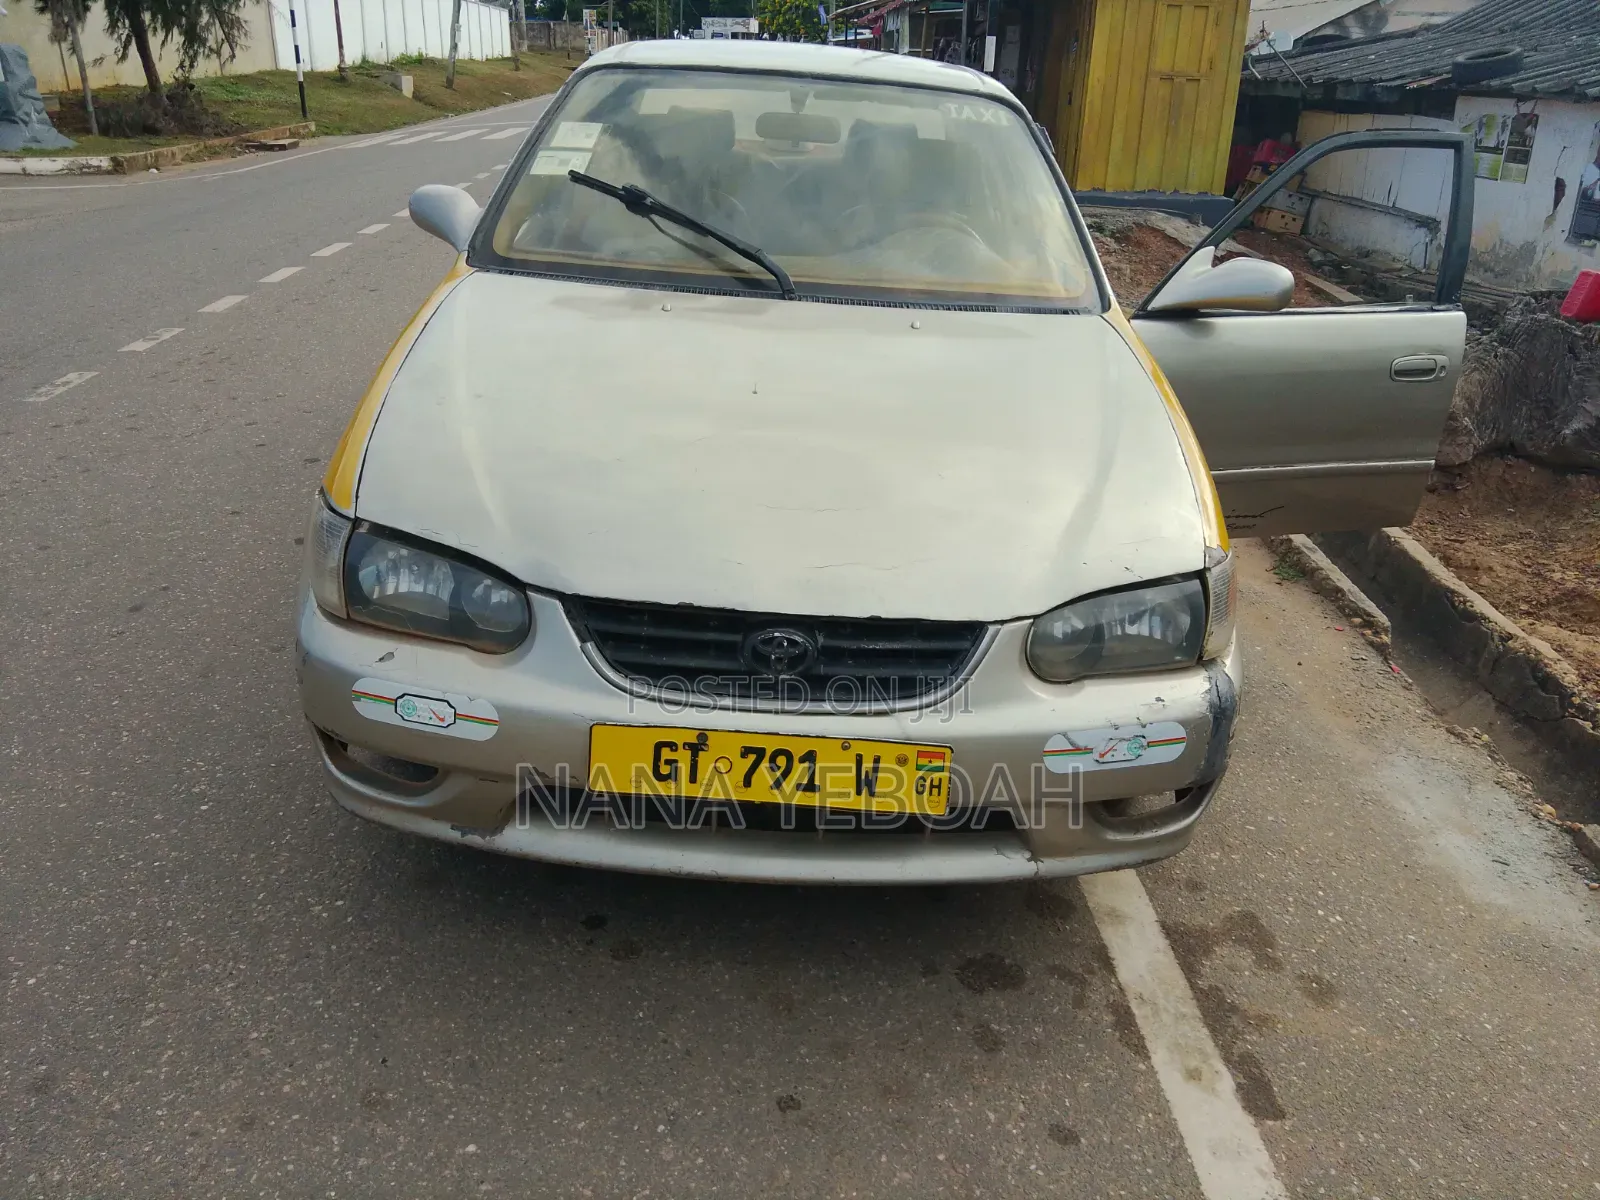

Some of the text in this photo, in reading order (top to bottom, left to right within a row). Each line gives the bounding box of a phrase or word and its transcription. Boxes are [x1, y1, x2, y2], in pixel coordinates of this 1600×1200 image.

[944, 103, 1010, 126] TAXI
[653, 740, 881, 797] GT 791 W
[914, 775, 943, 797] GH
